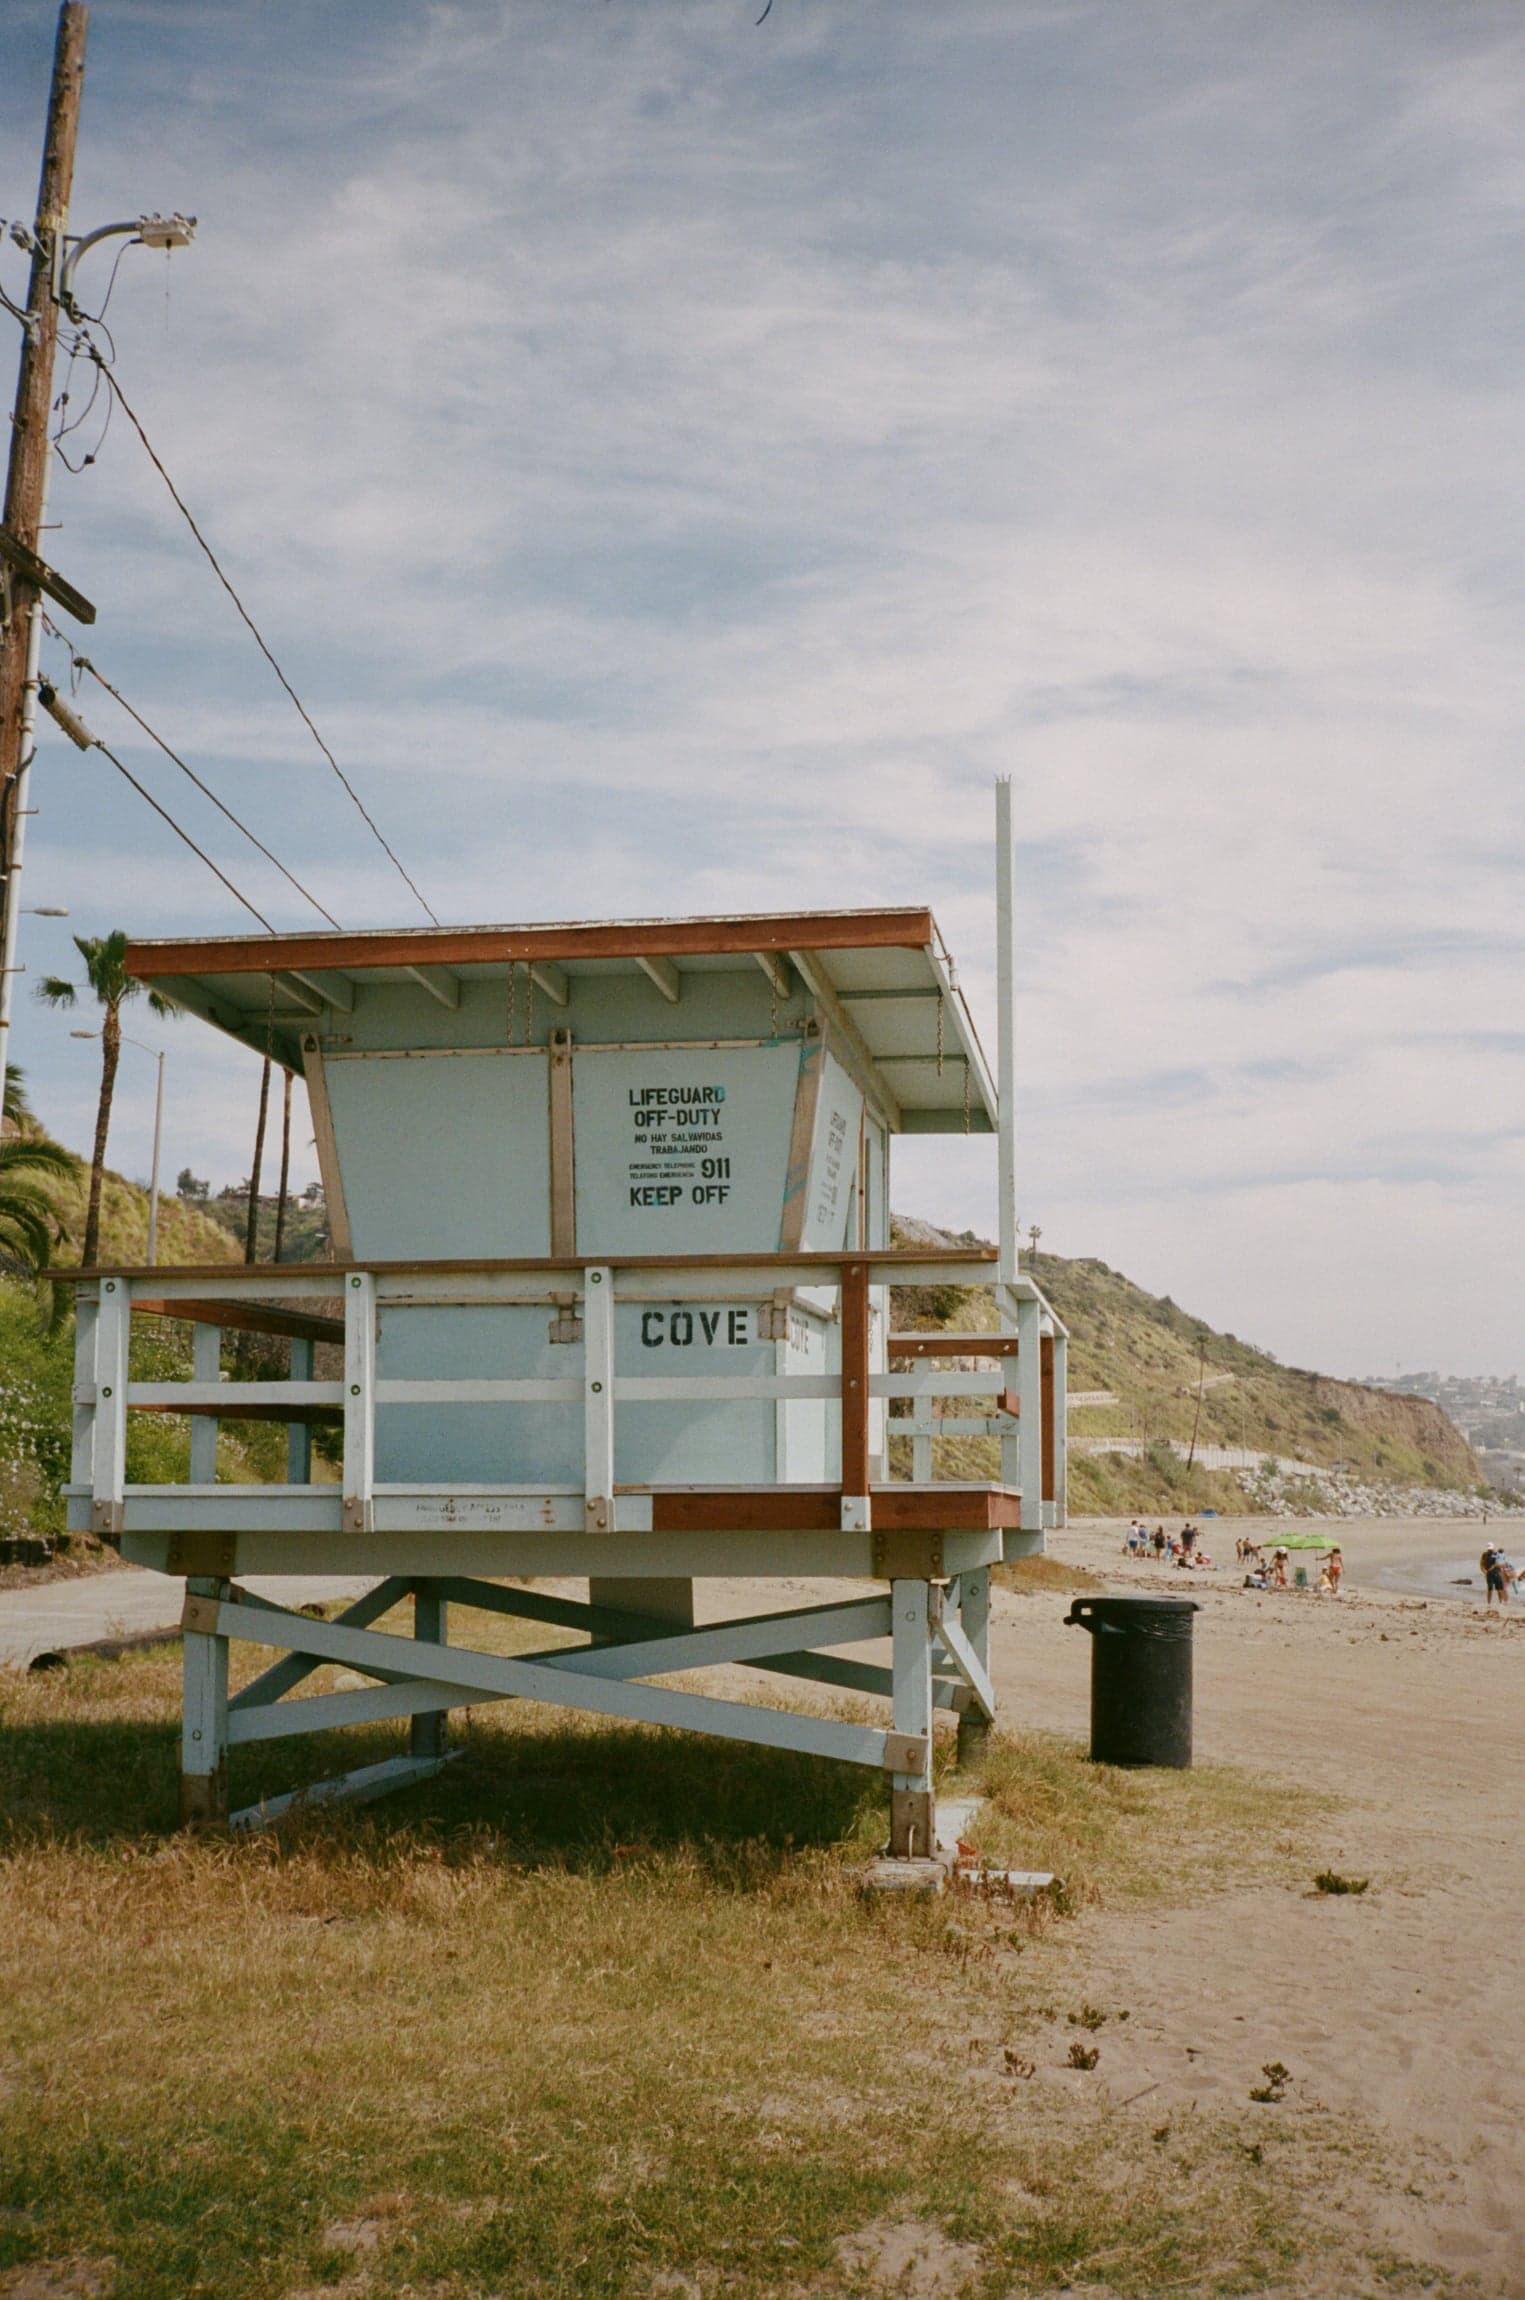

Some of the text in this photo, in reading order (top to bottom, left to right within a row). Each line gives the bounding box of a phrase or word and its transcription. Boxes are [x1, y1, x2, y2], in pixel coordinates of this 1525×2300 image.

[629, 1087, 726, 1106] LIFEGUARD
[634, 1109, 721, 1127] OFF-DUTY
[634, 1131, 723, 1144] NO HAY SALVAVIDAS
[650, 1144, 708, 1155] TRABAJANDO
[701, 1157, 731, 1179] 911
[630, 1185, 730, 1207] KEEP OFF
[641, 1310, 749, 1348] COVE
